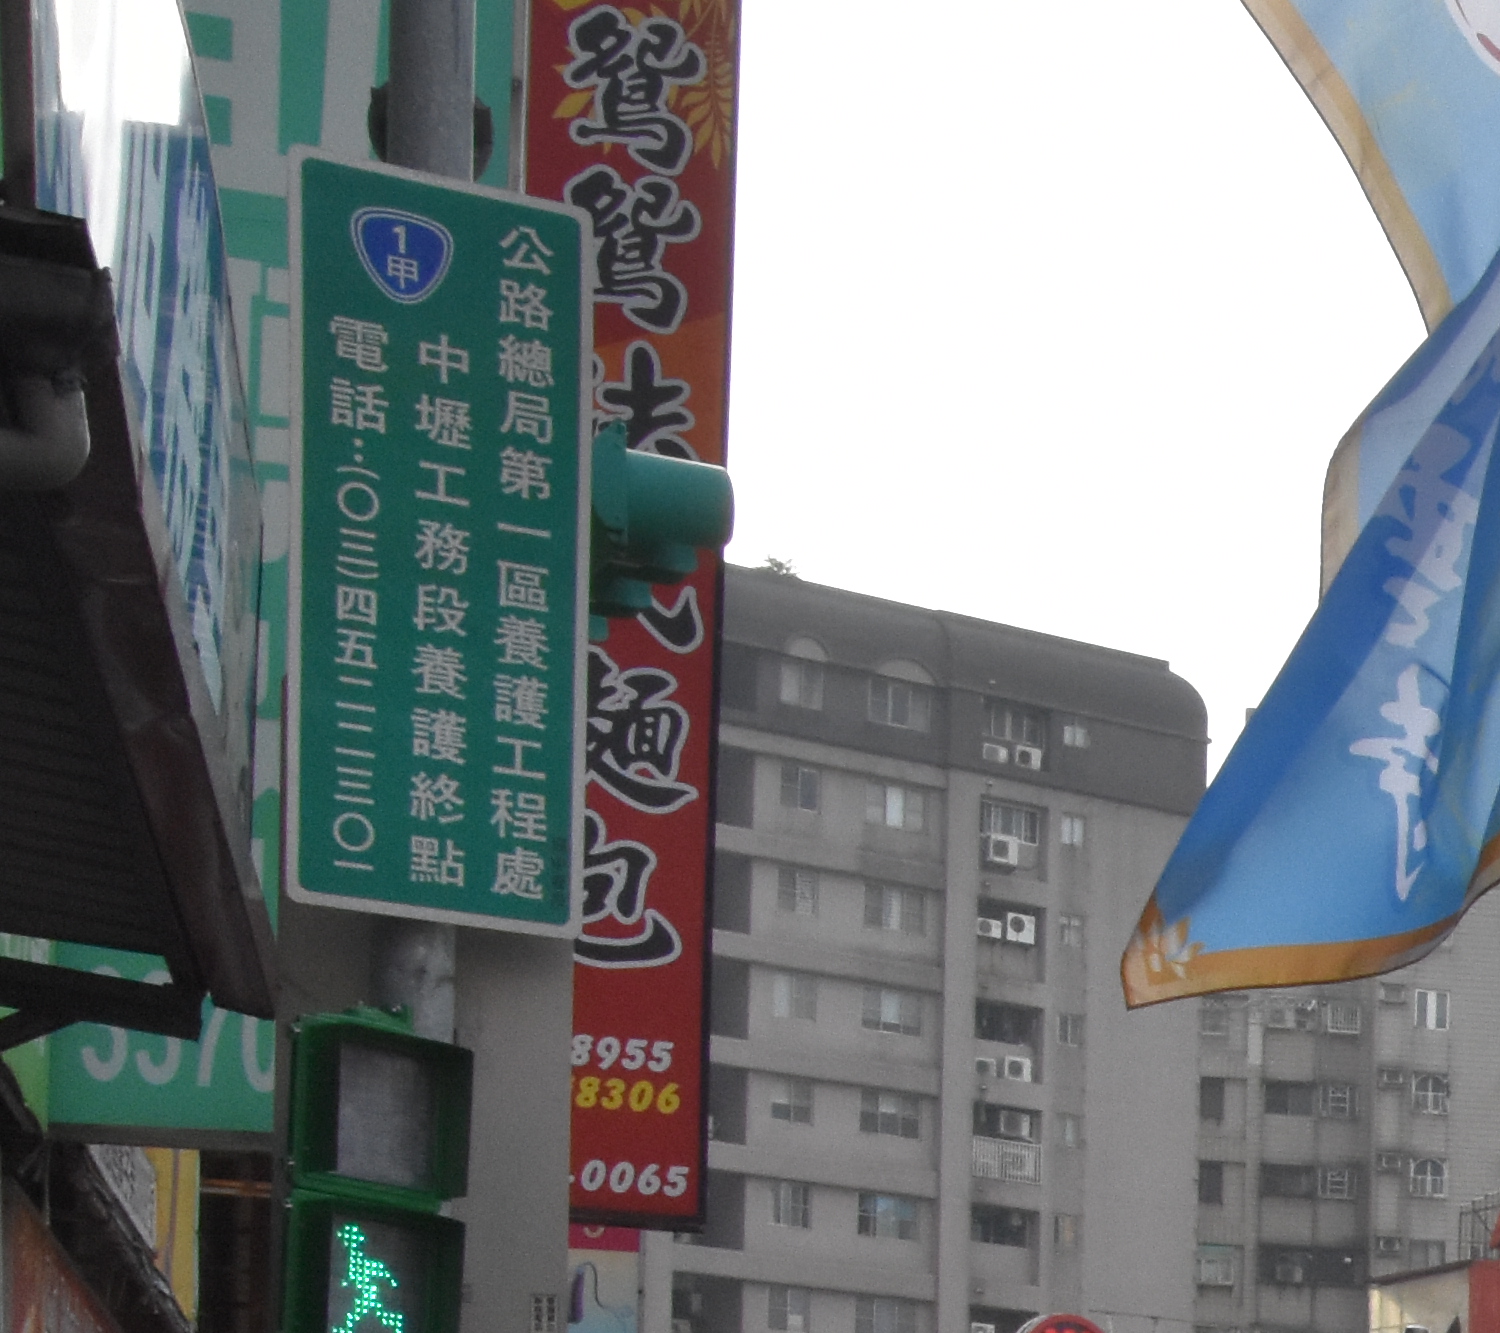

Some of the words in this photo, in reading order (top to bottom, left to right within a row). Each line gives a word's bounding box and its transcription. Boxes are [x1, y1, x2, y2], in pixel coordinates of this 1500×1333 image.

[391, 225, 408, 254] 1
[387, 255, 420, 290] 甲
[489, 225, 555, 900] 公路總局第一區養護工程處
[408, 334, 474, 888] 中壢工務段養護終點
[569, 1078, 682, 1117] 8306
